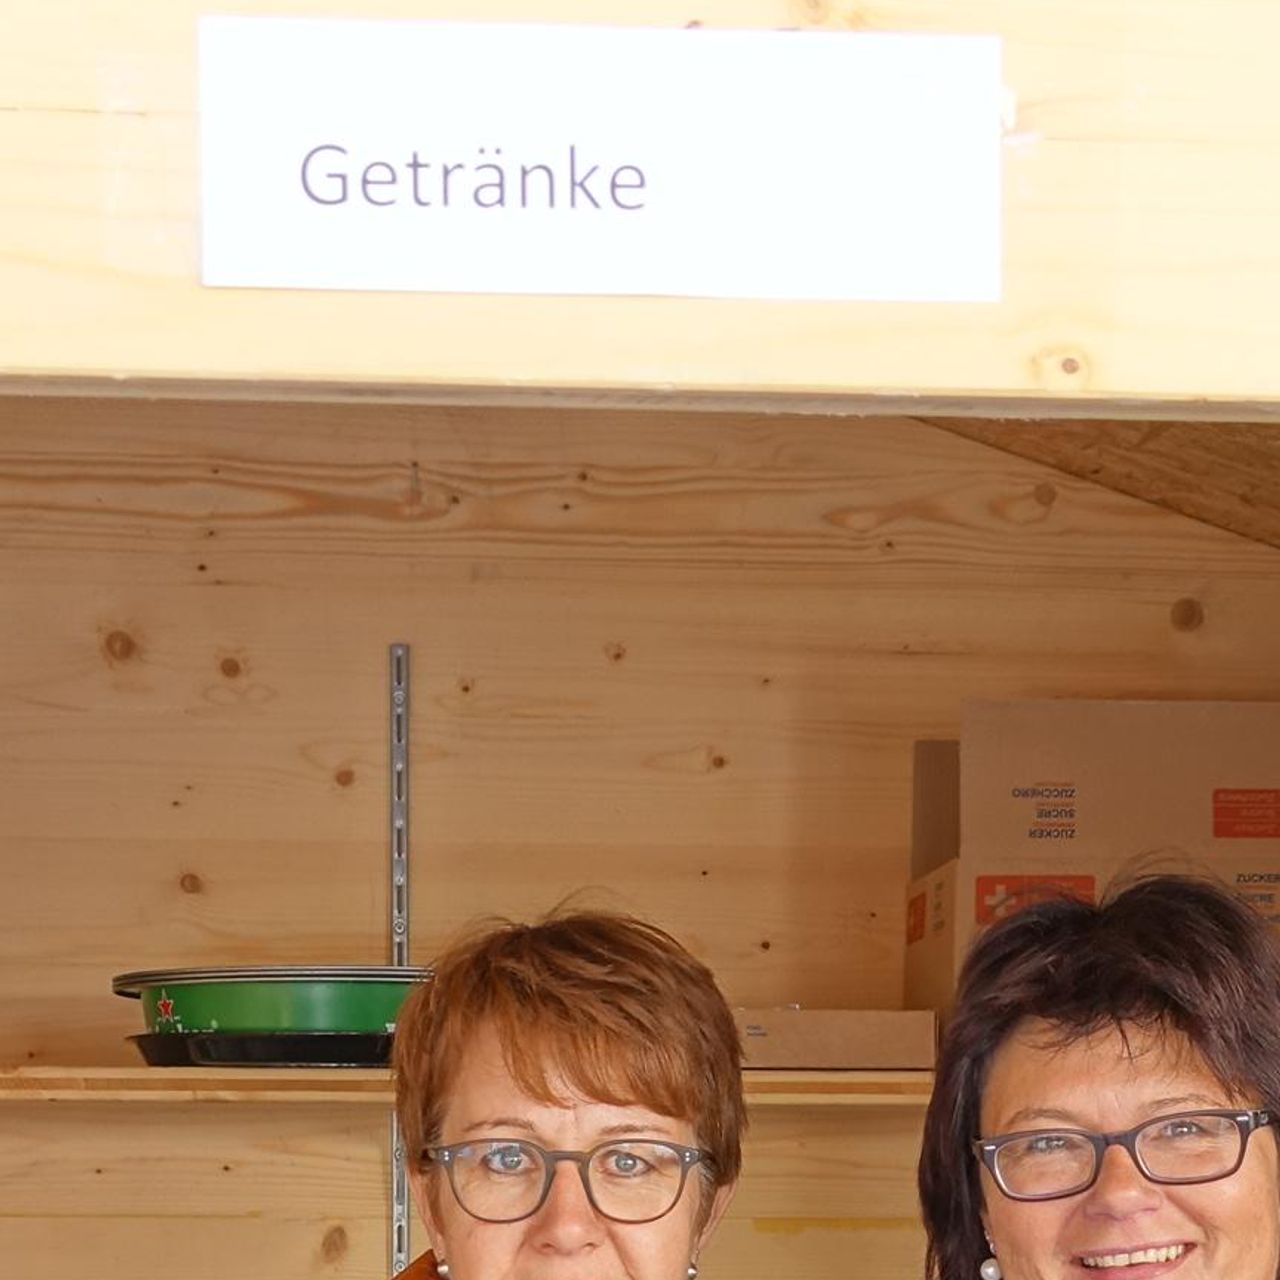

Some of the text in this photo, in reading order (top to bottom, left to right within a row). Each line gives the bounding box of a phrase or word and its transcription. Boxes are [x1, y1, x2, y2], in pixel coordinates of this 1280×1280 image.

[300, 143, 649, 211] Getränke
[1036, 808, 1076, 819] SUCRE
[1028, 828, 1076, 839] ZUCKER
